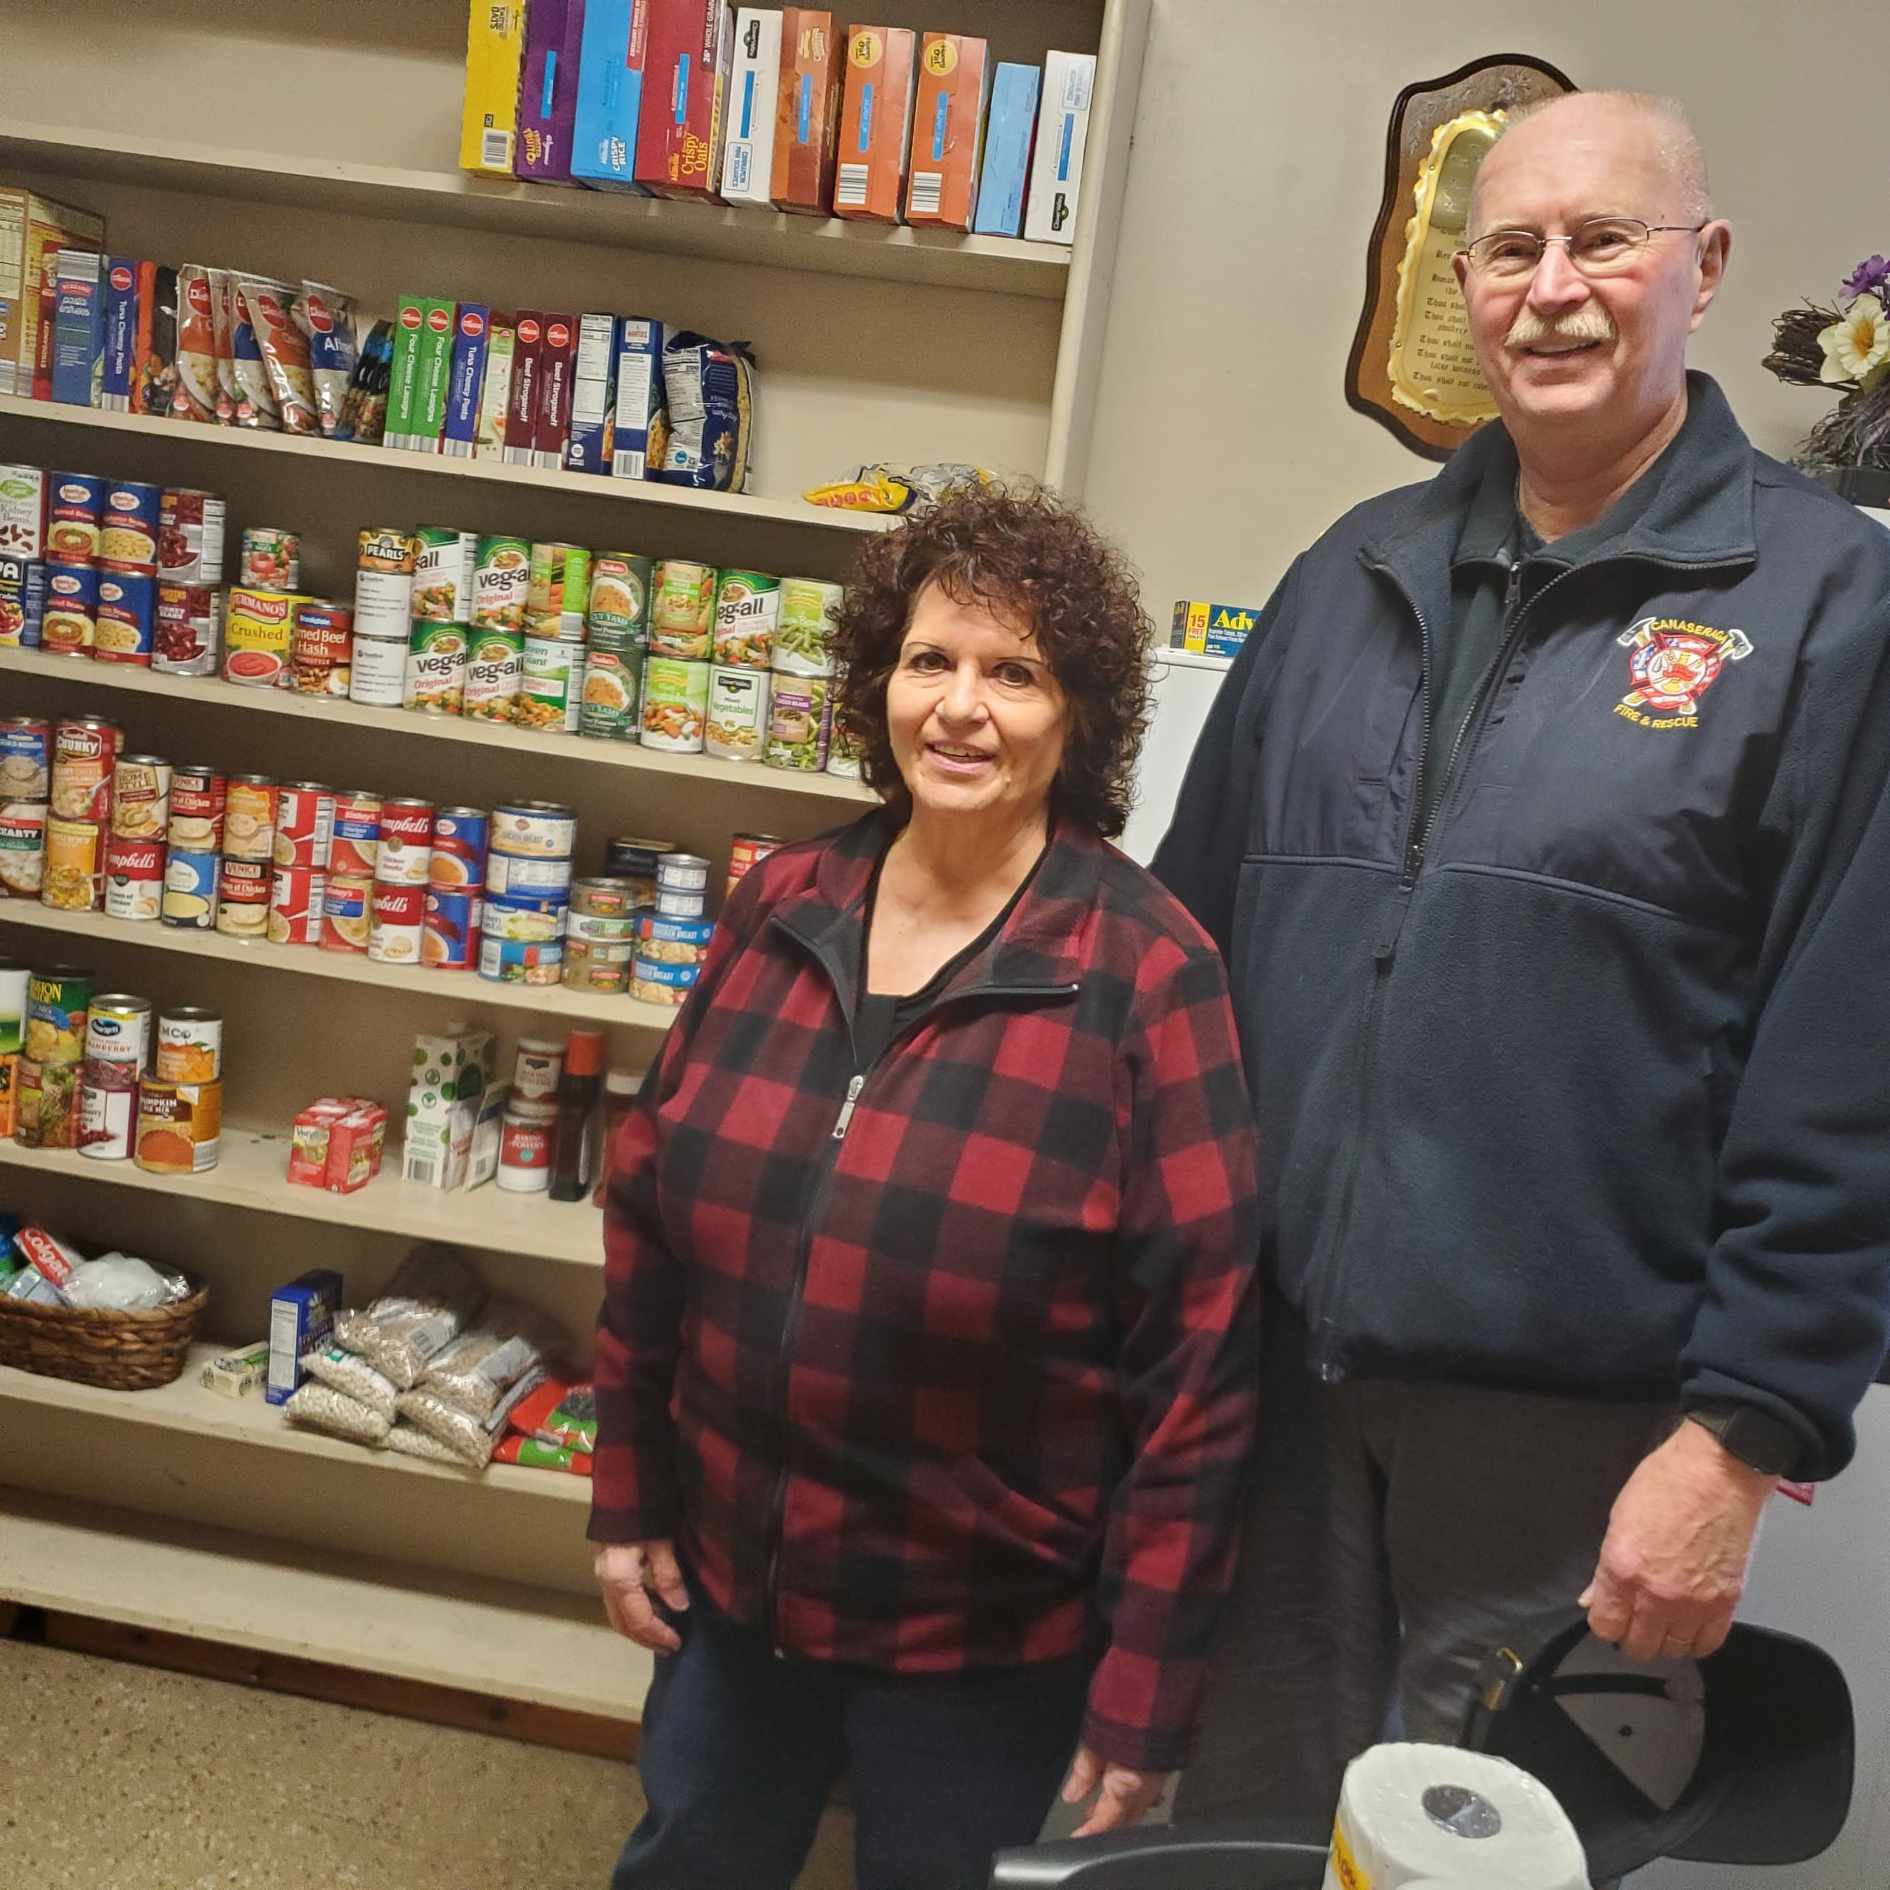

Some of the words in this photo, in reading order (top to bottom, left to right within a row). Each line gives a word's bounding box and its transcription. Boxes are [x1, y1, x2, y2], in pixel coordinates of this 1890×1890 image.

[681, 132, 699, 175] Crispy
[695, 142, 708, 171] Oats
[408, 334, 417, 354] Four
[436, 336, 445, 356] Four
[467, 347, 477, 365] Tuna
[404, 356, 414, 383] Cheese
[432, 358, 442, 387] Cheese
[525, 358, 533, 379] Beef
[554, 361, 562, 382] Beef
[463, 368, 473, 398] Cheesy
[401, 385, 411, 419] Lasagna
[426, 389, 437, 422] Lasagna
[459, 399, 469, 420] Pasta
[520, 382, 531, 423] Stroganoff
[550, 385, 561, 427] Stroganoff
[367, 545, 405, 560] PEARLS
[1190, 614, 1206, 629] 15
[1213, 609, 1255, 632] Adv
[231, 622, 283, 641] Crushed
[321, 630, 346, 642] Beef
[414, 676, 453, 690] Original
[1613, 703, 1639, 722] FIRE
[1639, 714, 1651, 727] &
[1652, 716, 1699, 729] RESCUE
[57, 736, 98, 754] CHUNKY
[227, 862, 257, 876] VENICE
